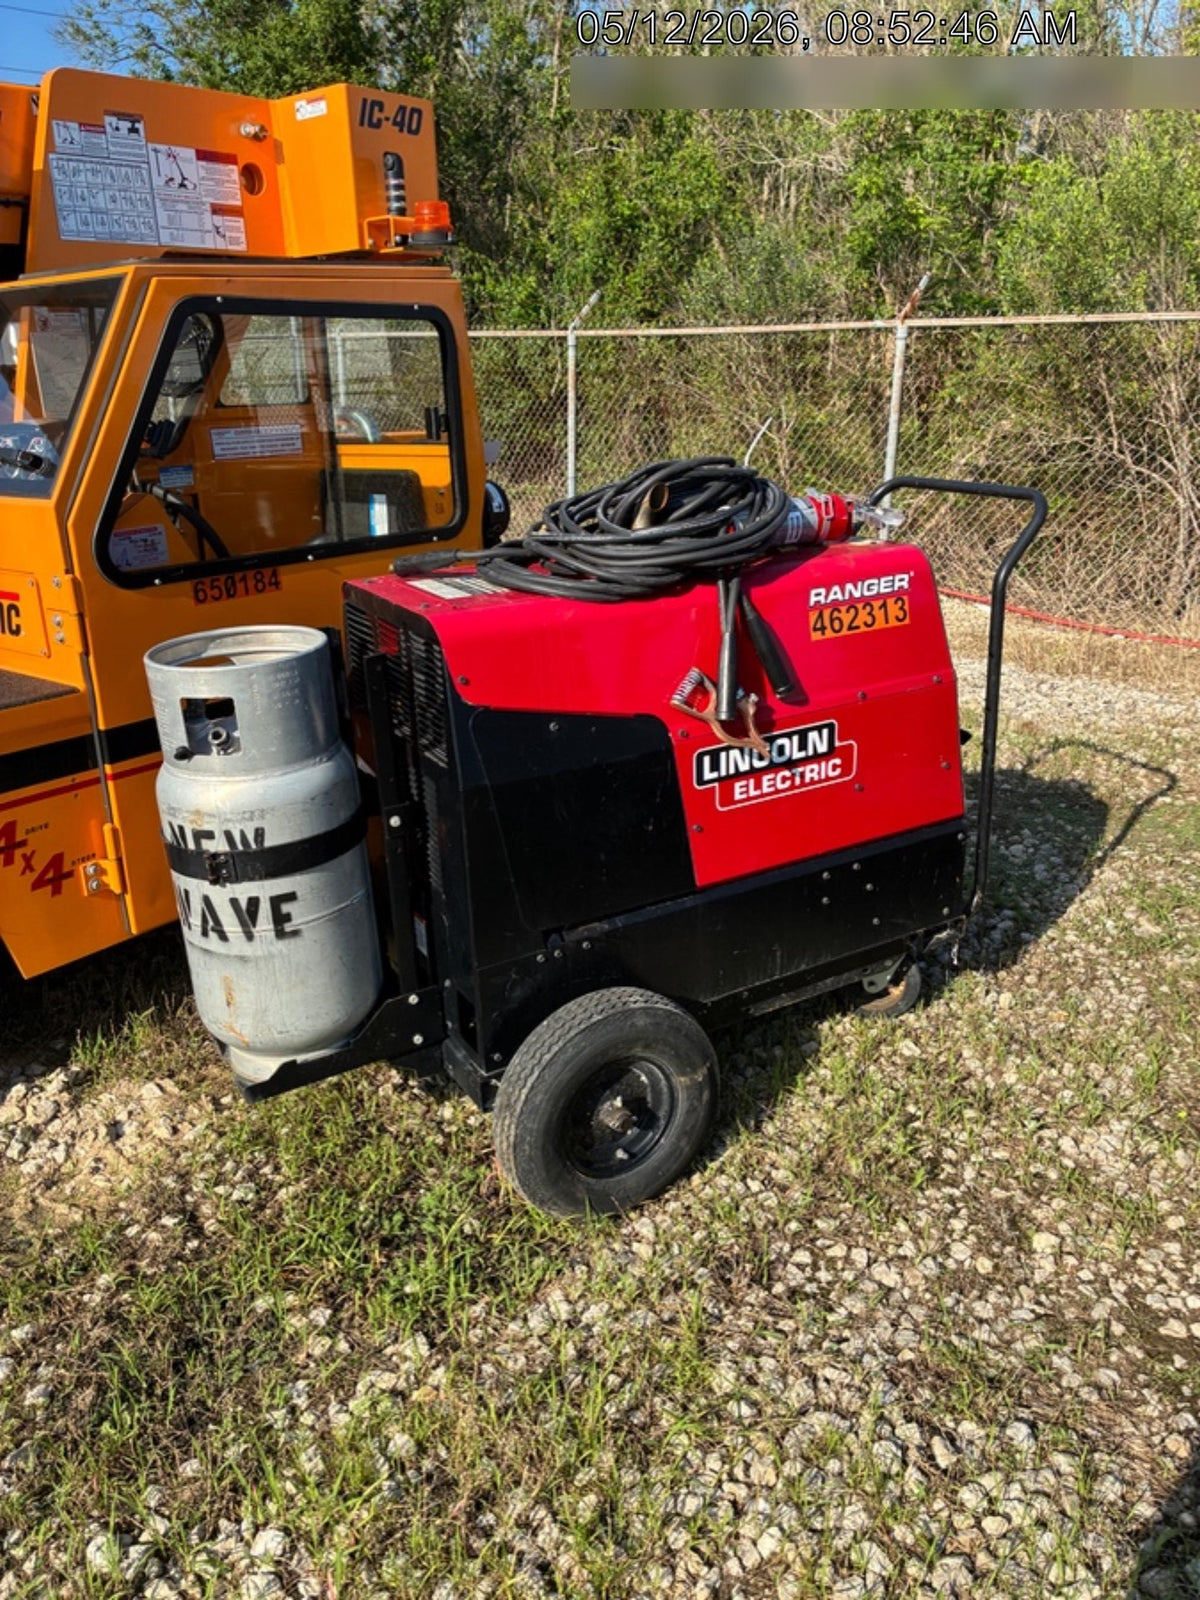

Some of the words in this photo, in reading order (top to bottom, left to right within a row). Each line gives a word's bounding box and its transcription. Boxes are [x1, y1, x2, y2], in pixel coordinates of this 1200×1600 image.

[358, 98, 423, 135] IC-40
[194, 568, 281, 604] 650184
[809, 573, 910, 607] RANGER
[812, 597, 908, 636] 462313
[703, 728, 829, 781] LINCOLN
[734, 758, 842, 800] ELECTRIC
